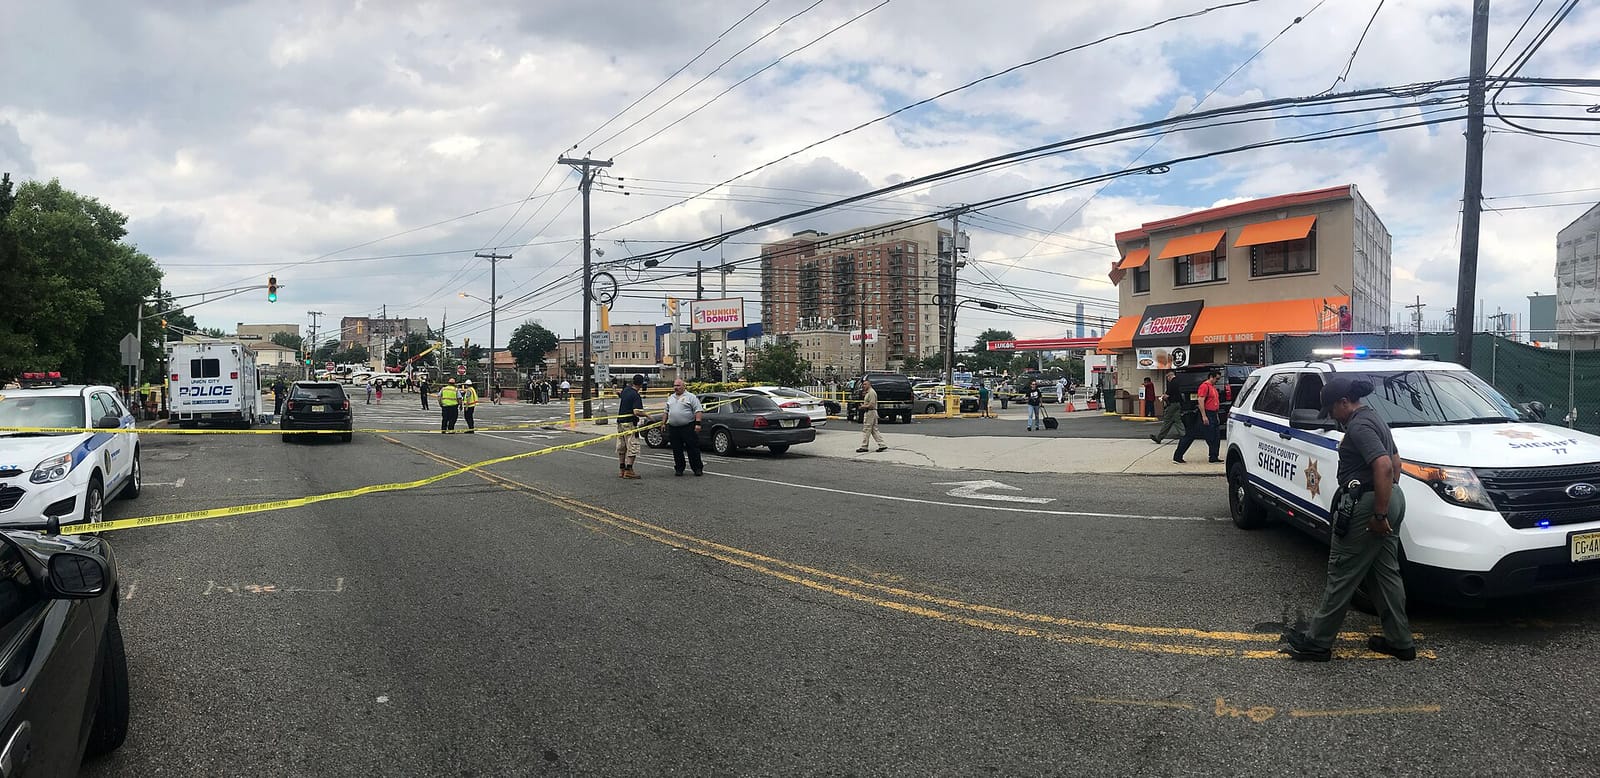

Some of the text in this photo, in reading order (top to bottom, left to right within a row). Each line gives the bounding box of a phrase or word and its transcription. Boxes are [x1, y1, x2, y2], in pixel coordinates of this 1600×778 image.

[706, 315, 739, 323] DONUTS
[1150, 323, 1186, 334] DONUTS
[1203, 335, 1226, 343] COFFEE
[1234, 333, 1254, 341] MORE
[179, 385, 234, 397] POLICE
[1258, 441, 1300, 462] HUDSON COUNTY
[1258, 451, 1297, 481] SHERIFF
